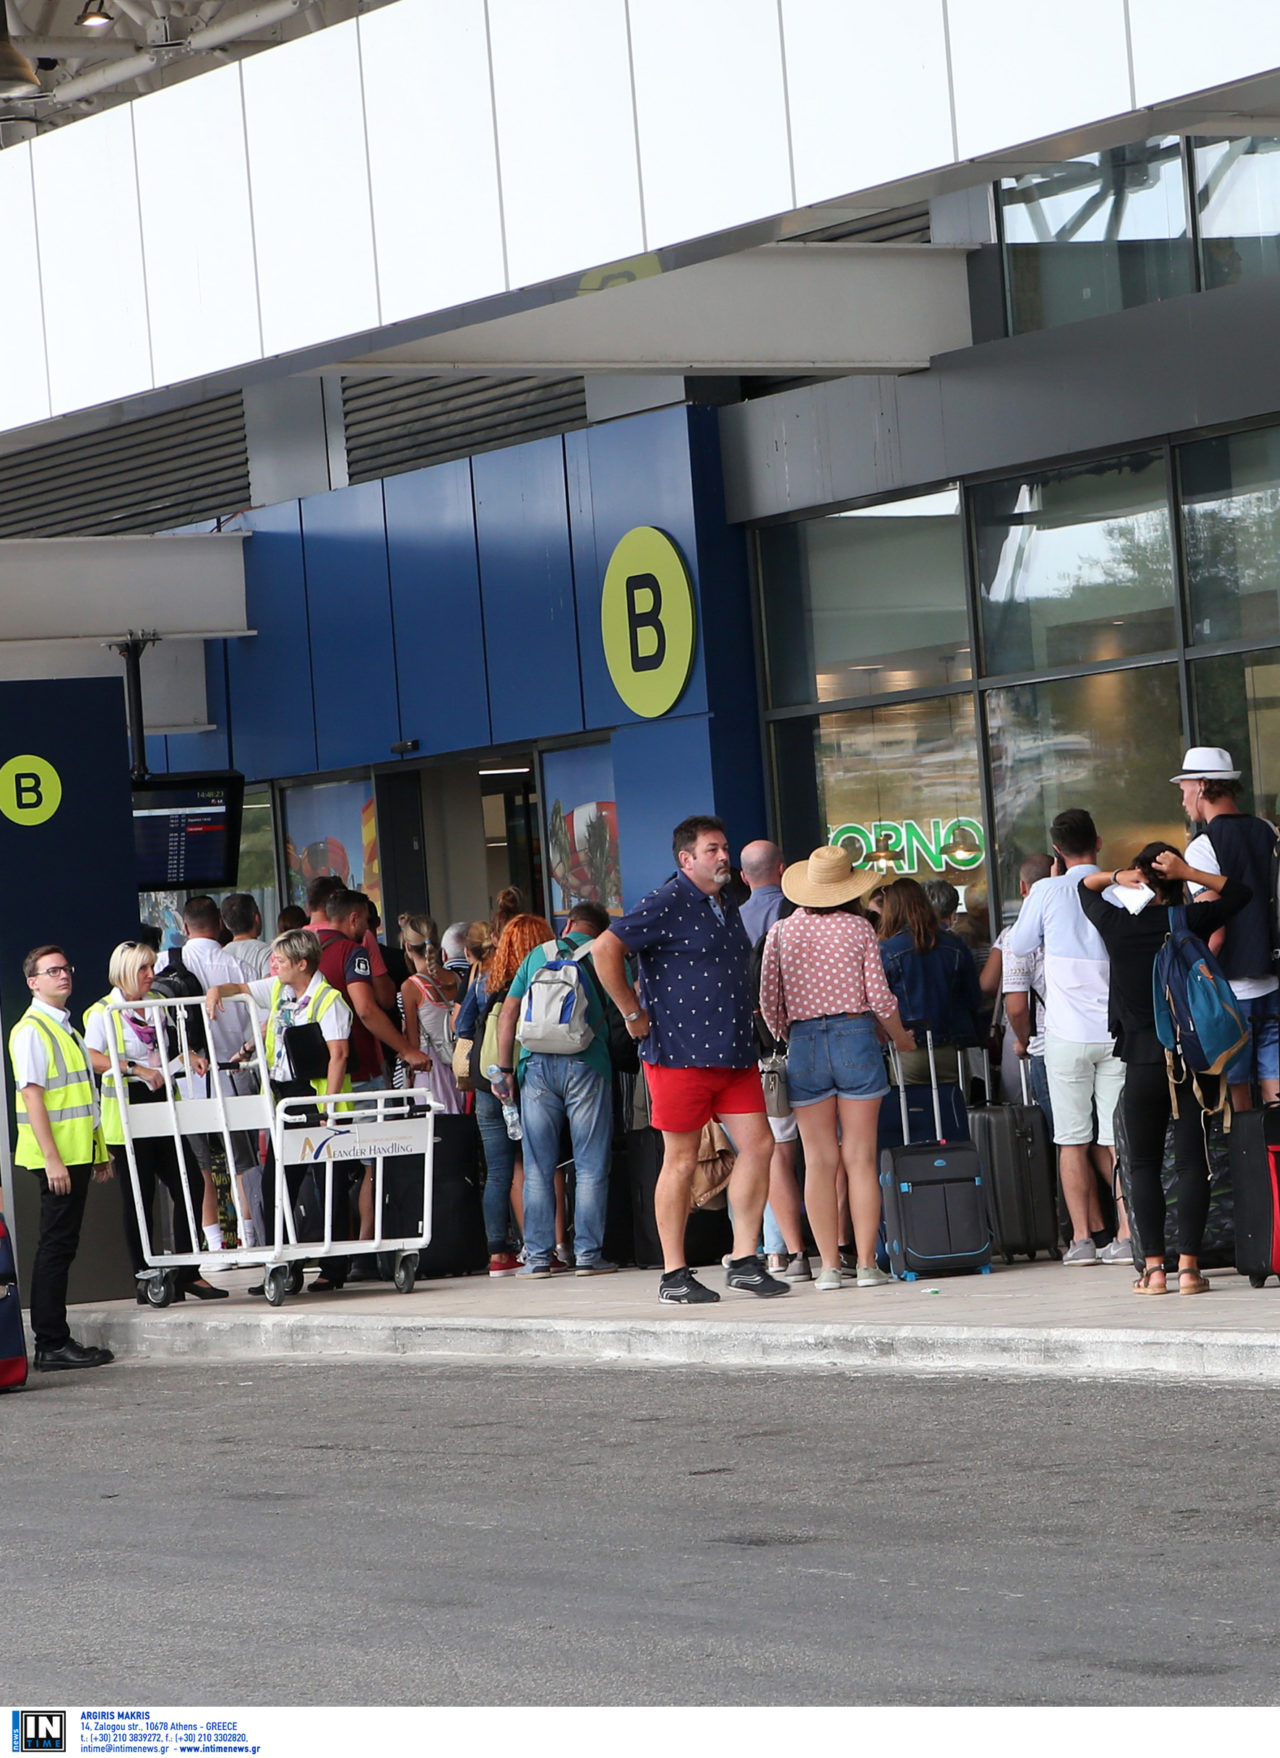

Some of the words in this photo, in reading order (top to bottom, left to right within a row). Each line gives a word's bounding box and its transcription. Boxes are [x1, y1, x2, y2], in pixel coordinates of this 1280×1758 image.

[626, 573, 666, 672] B
[15, 773, 43, 809] B
[827, 816, 986, 875] ORNO
